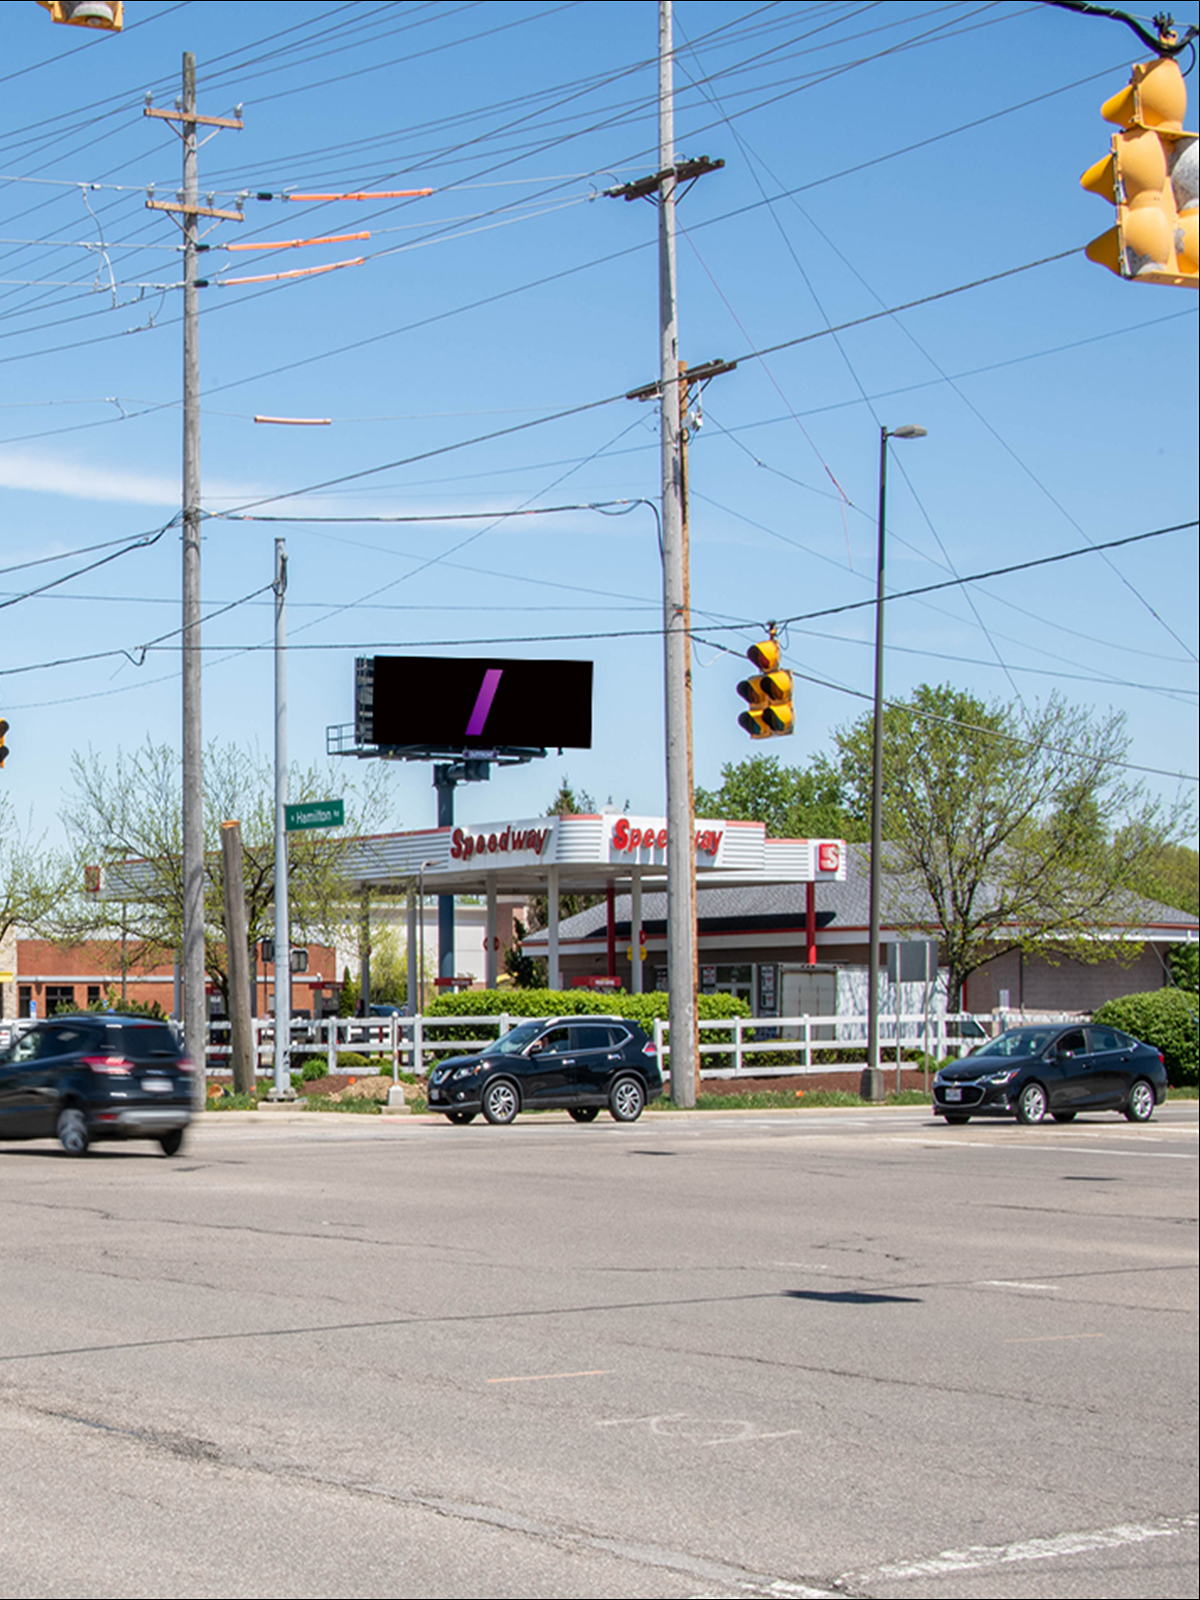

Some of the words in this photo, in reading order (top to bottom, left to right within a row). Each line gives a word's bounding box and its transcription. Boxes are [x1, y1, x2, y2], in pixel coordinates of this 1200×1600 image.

[296, 809, 332, 824] Hamilton
[450, 825, 549, 861] Speedway
[613, 818, 723, 857] Speeay
